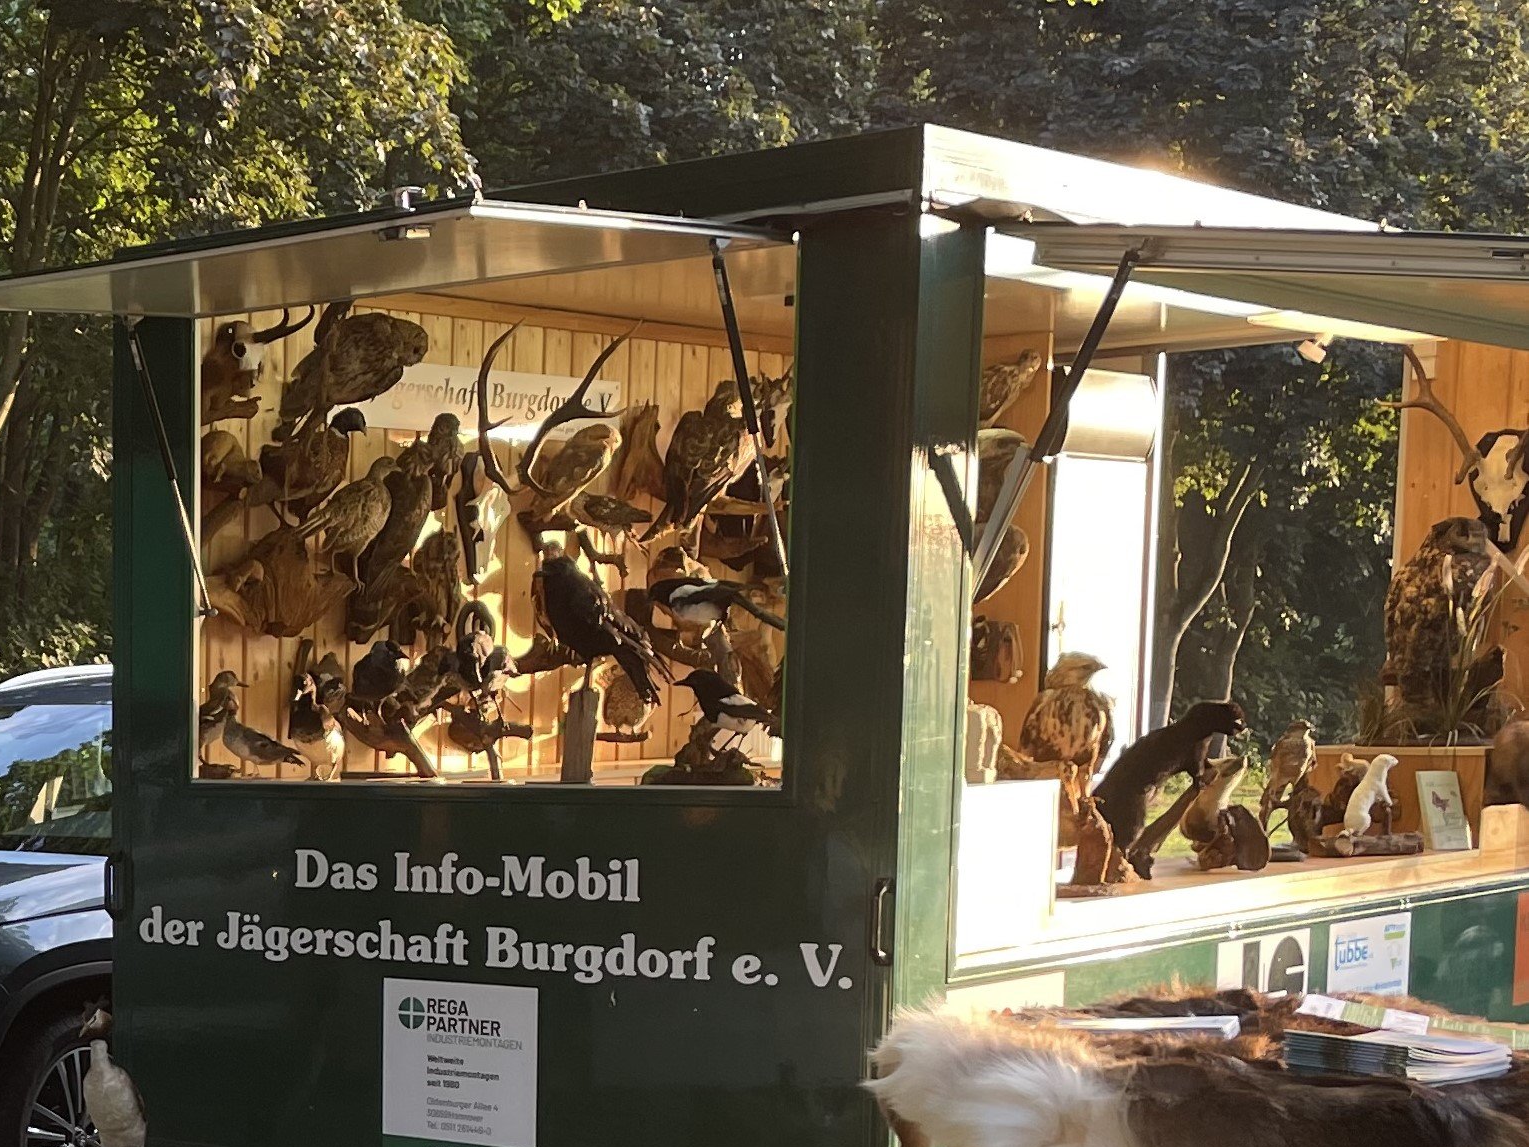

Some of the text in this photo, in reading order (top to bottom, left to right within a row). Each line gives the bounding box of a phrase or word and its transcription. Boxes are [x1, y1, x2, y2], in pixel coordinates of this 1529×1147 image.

[391, 377, 478, 415] gerschaf
[490, 382, 570, 420] Burgdor
[294, 849, 640, 902] Das Info-Mobil
[139, 905, 853, 989] der Jägerschaft Burgdorf e. V.
[427, 998, 469, 1016] REGA
[427, 1016, 500, 1037] PARTNER
[427, 1034, 522, 1050] INDUSTRIEMONTAGEN
[427, 1067, 499, 1081] Industriemontagen
